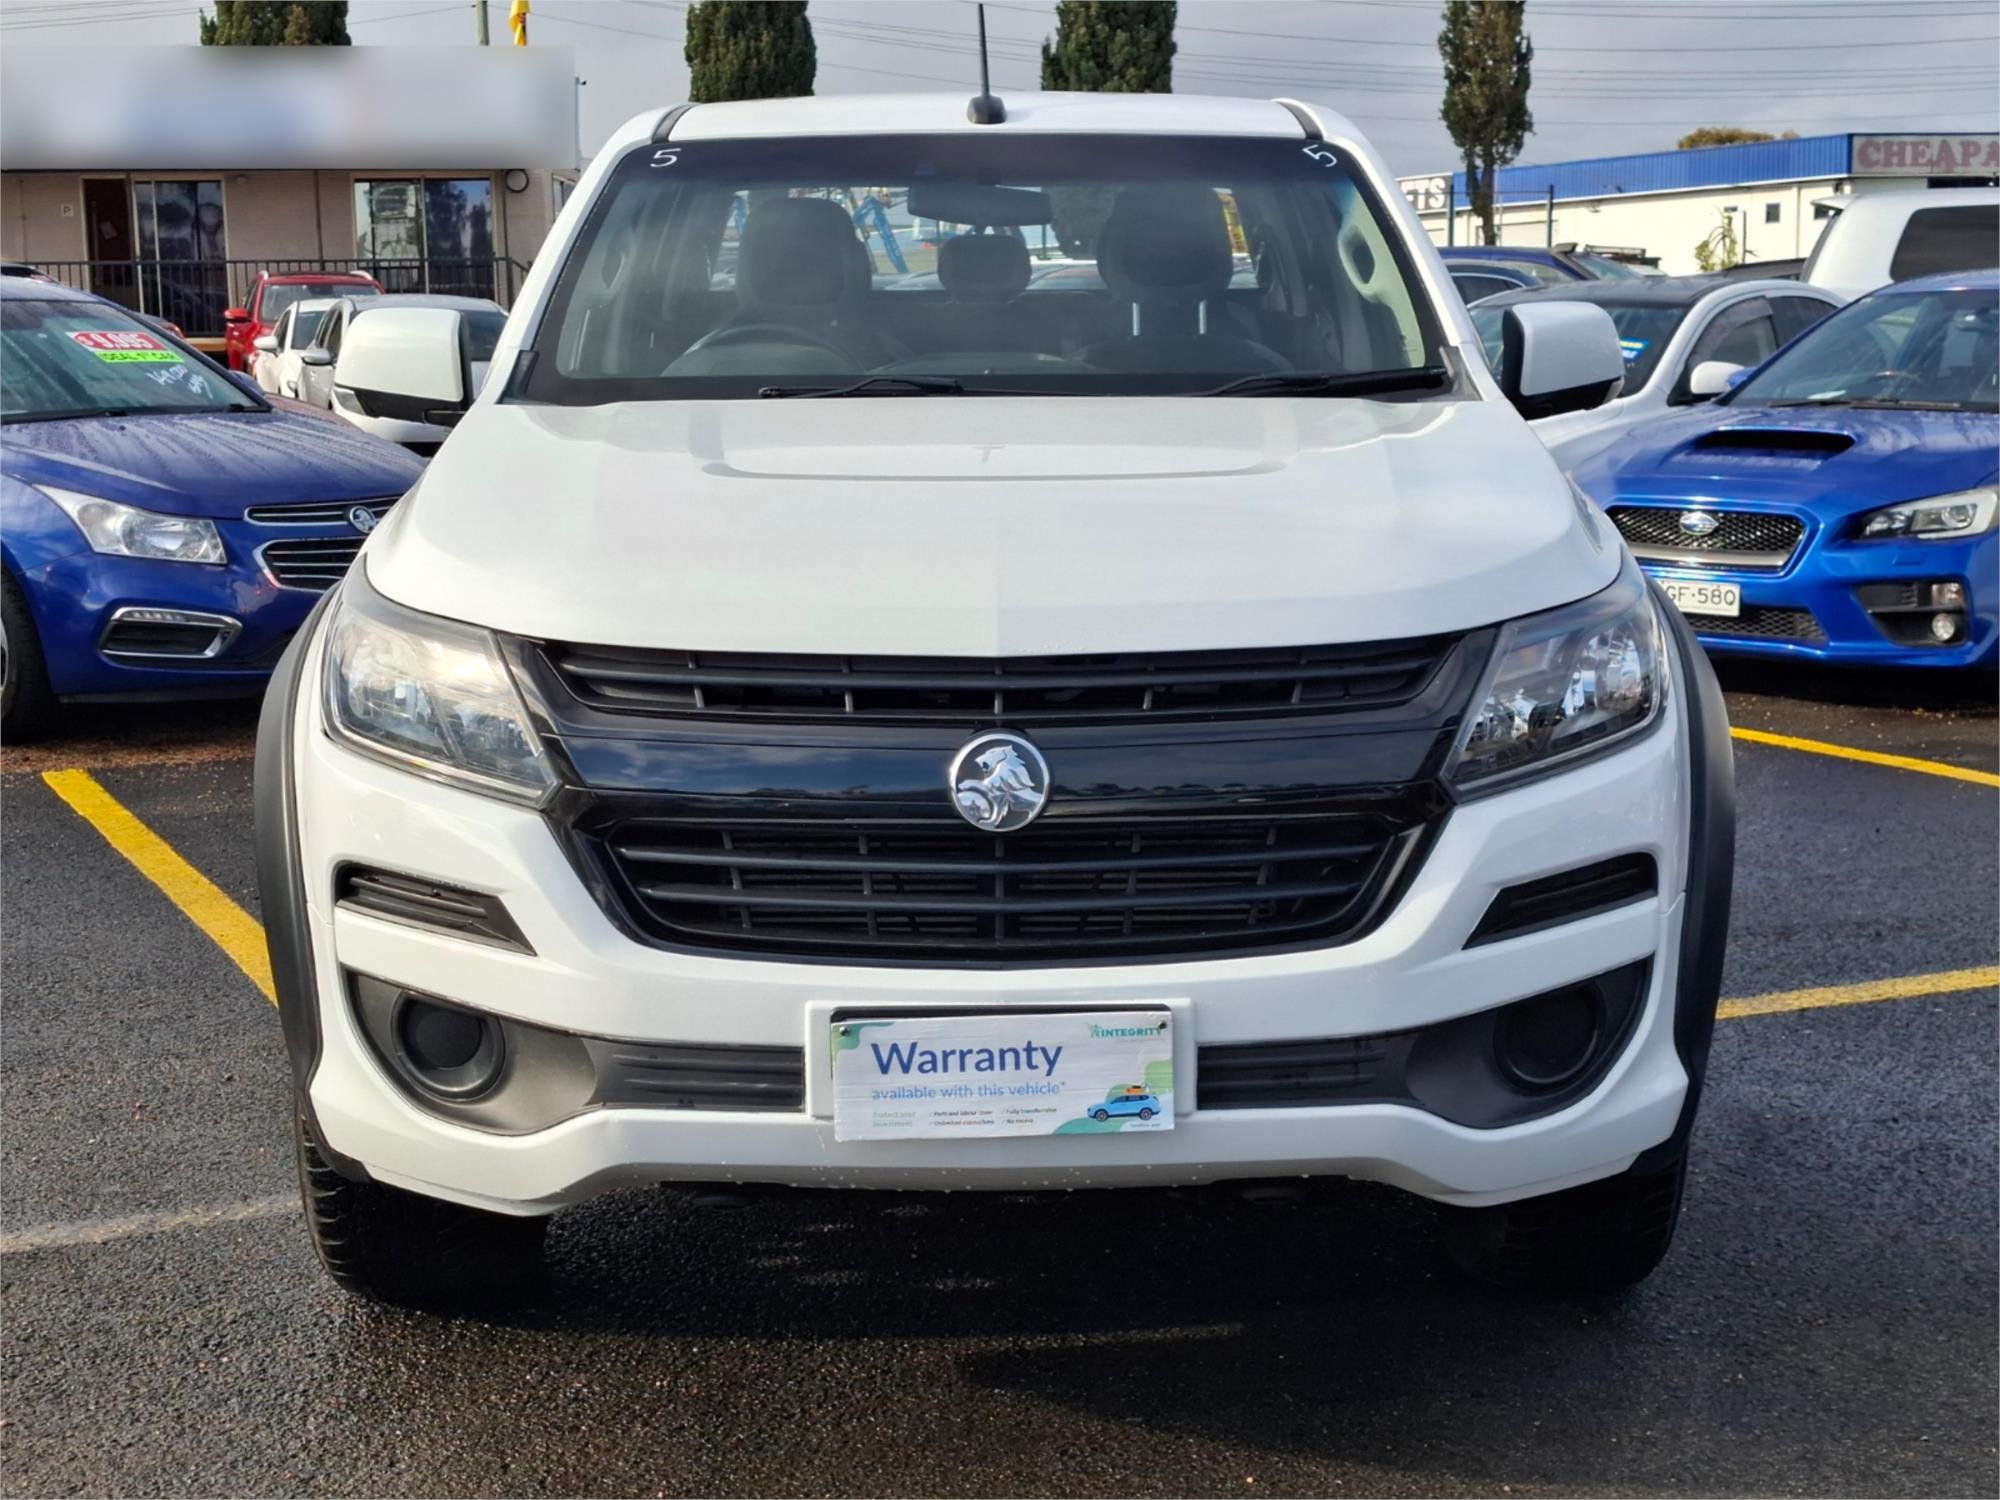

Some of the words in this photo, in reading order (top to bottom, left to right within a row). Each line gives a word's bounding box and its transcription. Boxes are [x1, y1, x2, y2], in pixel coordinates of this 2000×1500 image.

[651, 148, 681, 167] 5
[1302, 144, 1337, 167] 5
[1101, 1027, 1162, 1037] INTEGRITY
[871, 1040, 1063, 1077] Warranty
[872, 1086, 936, 1100] available
[941, 1084, 973, 1098] with
[978, 1083, 1004, 1097] this
